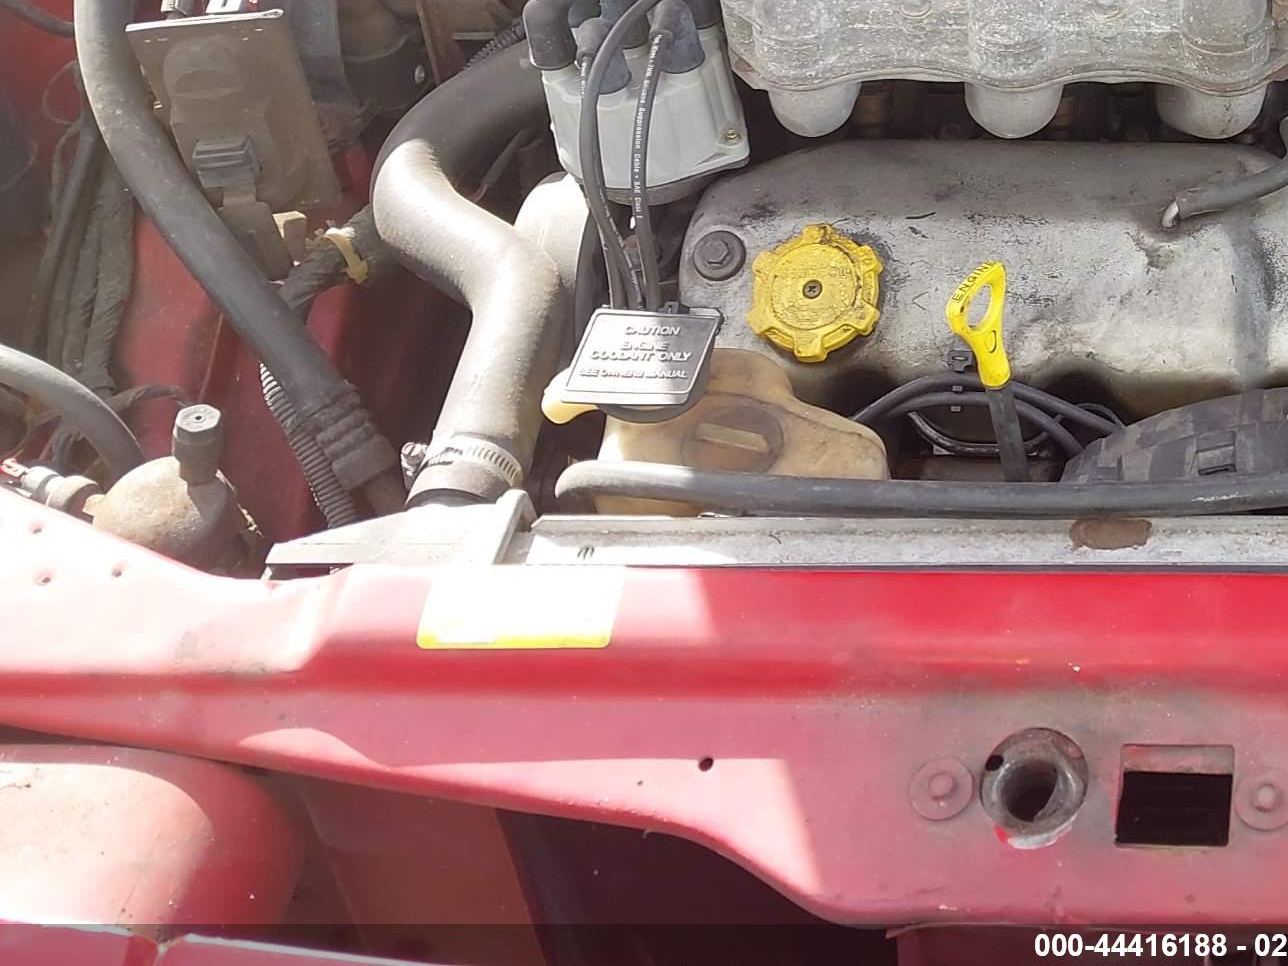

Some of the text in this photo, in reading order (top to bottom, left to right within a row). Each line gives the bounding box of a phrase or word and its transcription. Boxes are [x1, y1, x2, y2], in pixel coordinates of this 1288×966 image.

[635, 107, 646, 149] Suppression
[633, 153, 643, 173] Cable
[952, 259, 995, 303] ENGINE
[624, 325, 681, 336] CAUTION
[620, 341, 670, 352] ENGINE
[590, 350, 693, 363] COOLANT ONLY
[579, 368, 600, 378] SEE
[645, 369, 689, 379] MANUAL
